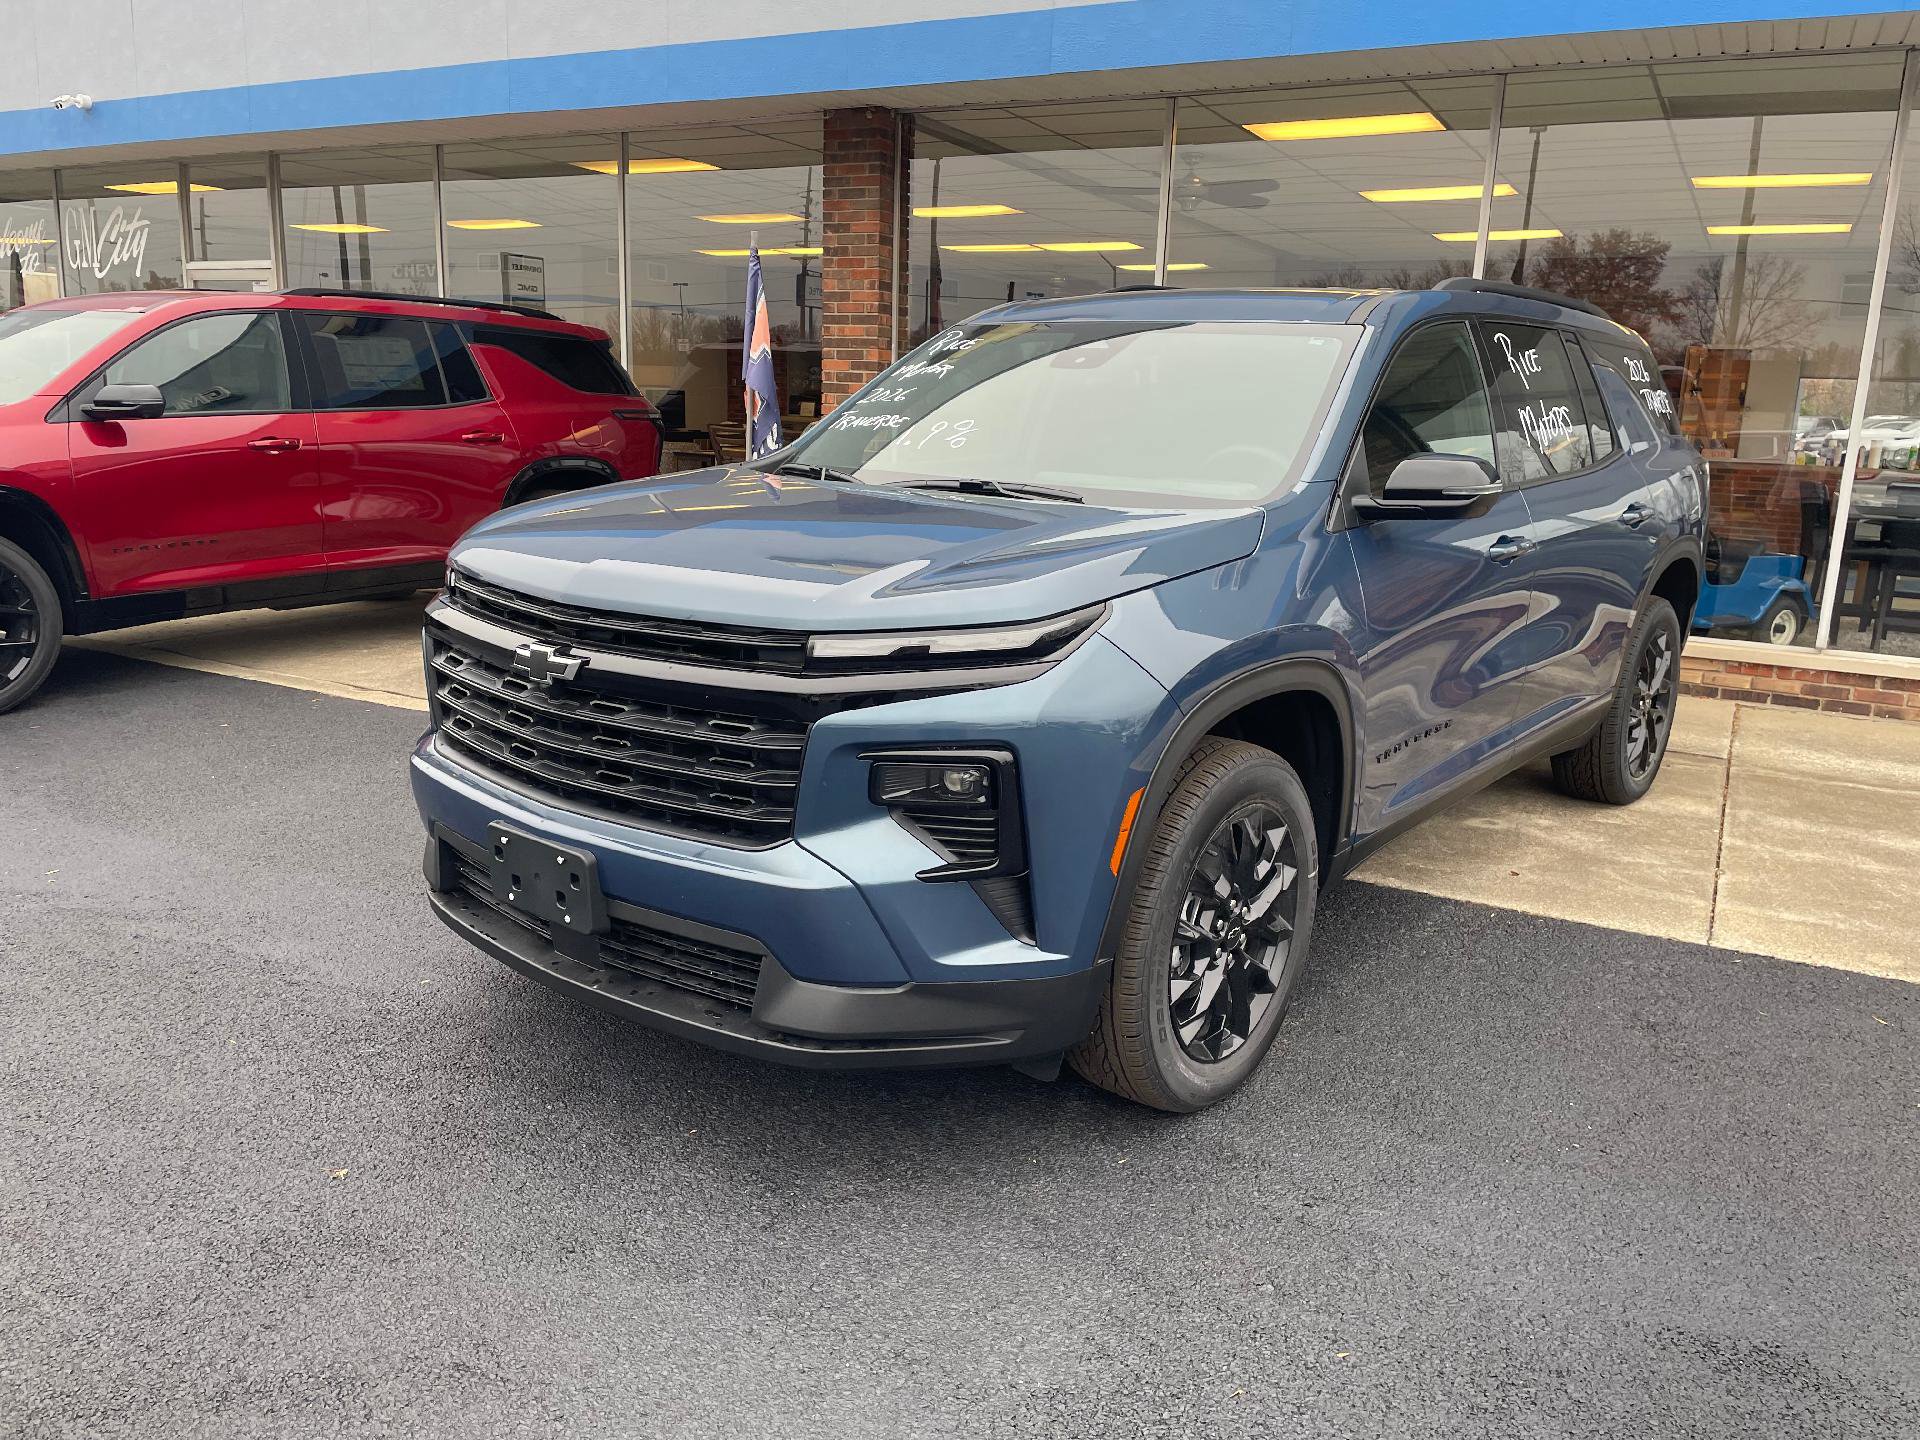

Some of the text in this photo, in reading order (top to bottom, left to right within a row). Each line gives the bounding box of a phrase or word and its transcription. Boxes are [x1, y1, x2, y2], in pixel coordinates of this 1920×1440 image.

[65, 205, 151, 278] GM City
[857, 387, 917, 405] 2026
[1375, 718, 1454, 764] TRAVERSE
